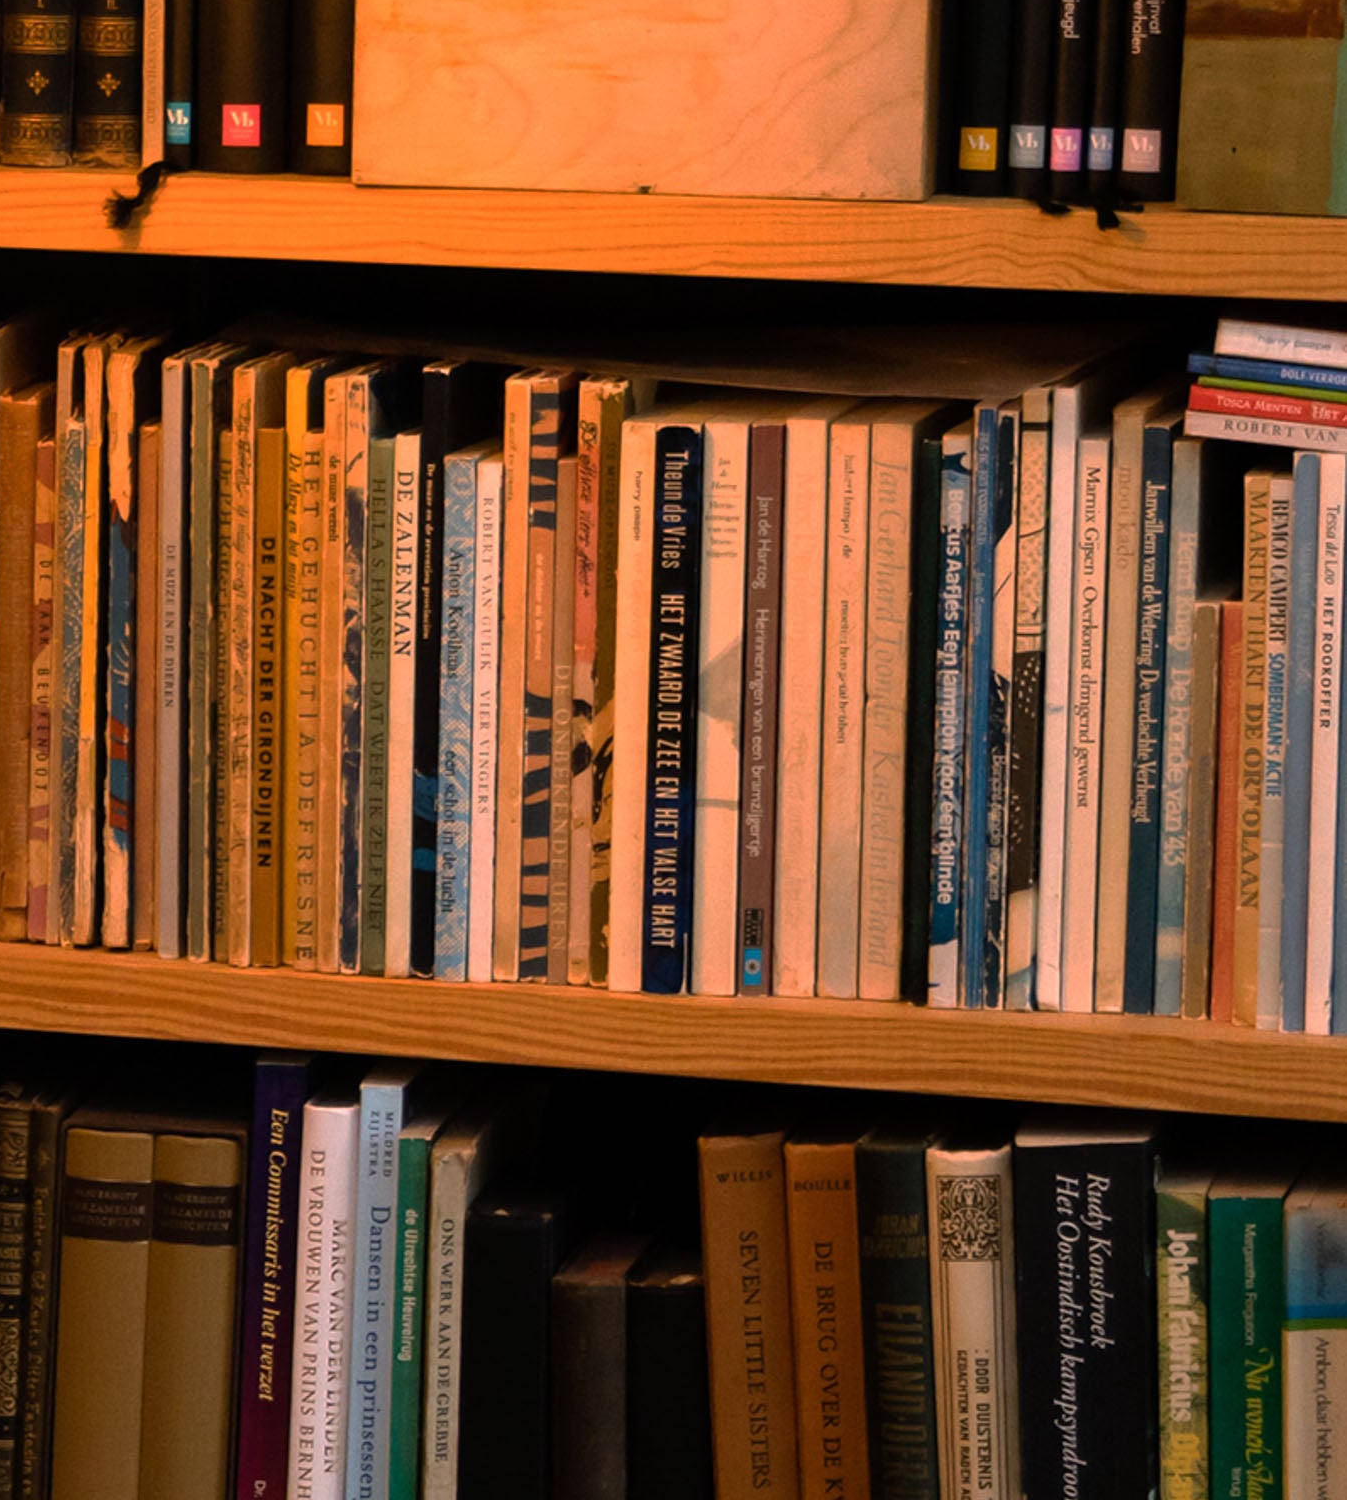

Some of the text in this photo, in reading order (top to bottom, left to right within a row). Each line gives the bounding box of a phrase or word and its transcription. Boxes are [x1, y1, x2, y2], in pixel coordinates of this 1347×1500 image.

[255, 536, 276, 867] DE NACHT DER GIRONDIJNEN
[309, 1149, 325, 1176] DE
[1056, 1174, 1078, 1216] Het
[304, 1184, 324, 1294] VROUWEN
[813, 1241, 835, 1271] DE
[1079, 1174, 1114, 1349] Rudy Kousbroek
[1056, 1221, 1082, 1348] Oostindisch
[303, 1302, 321, 1344] VAN
[815, 1286, 837, 1352] BRUG
[299, 1353, 319, 1415] PRINS
[737, 1231, 770, 1489] SEVEN LITTLE SISTERS
[818, 1365, 839, 1431] OVER
[822, 1438, 843, 1468] DE
